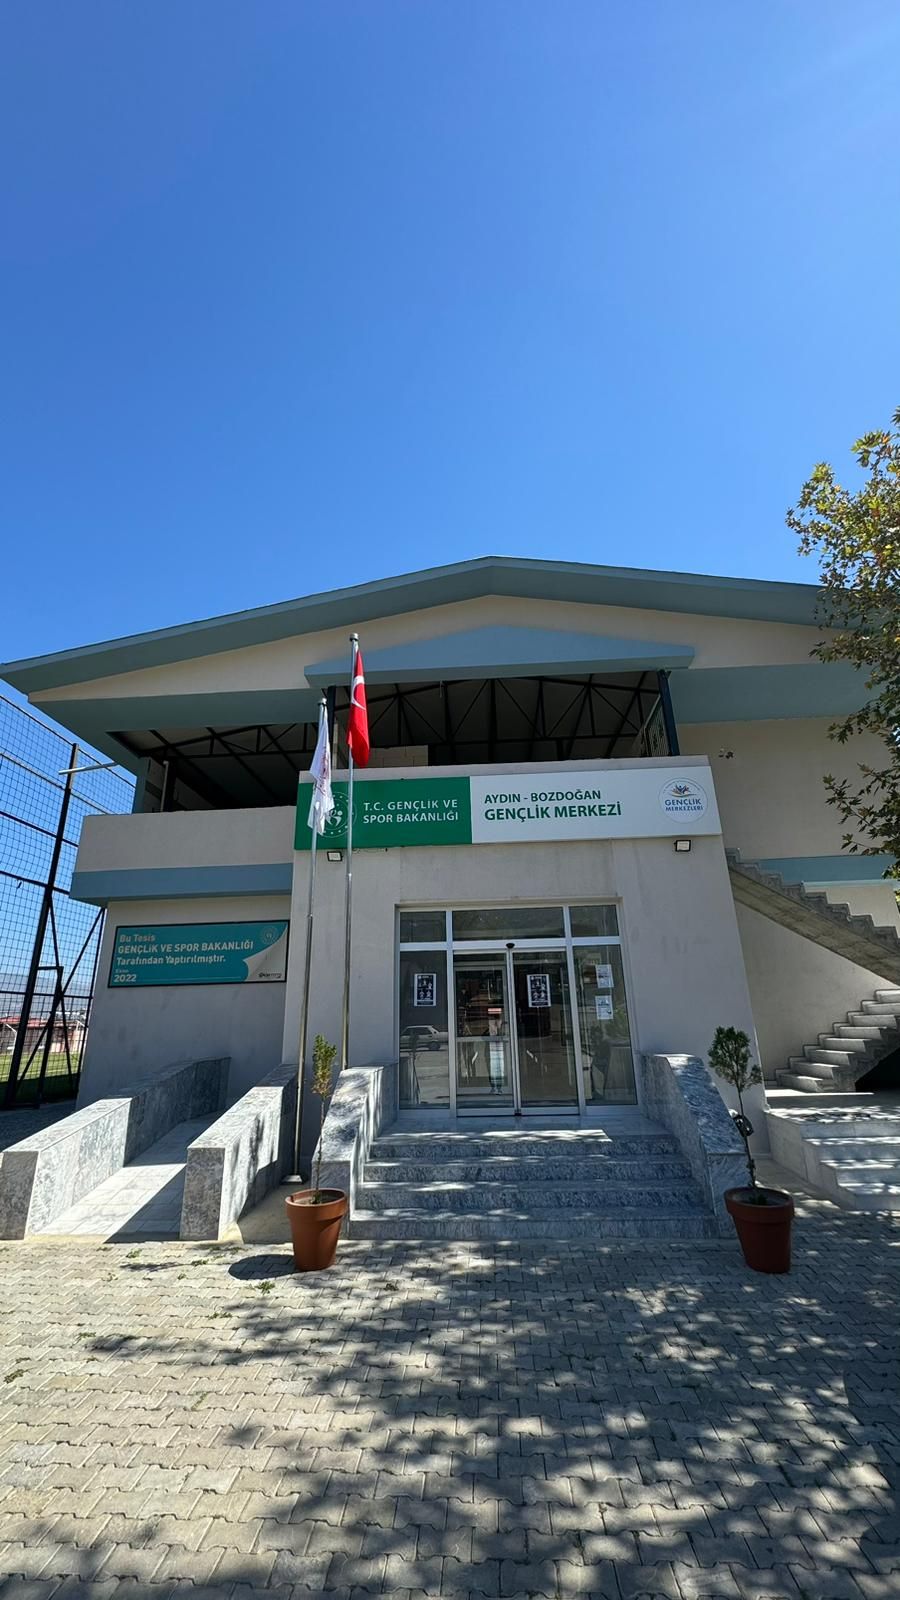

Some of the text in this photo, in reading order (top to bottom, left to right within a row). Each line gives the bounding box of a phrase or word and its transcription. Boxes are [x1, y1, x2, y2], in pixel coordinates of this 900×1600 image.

[484, 793, 521, 804] AYDIN
[530, 788, 601, 803] BOZDOĞAN
[363, 802, 384, 811] T.C.
[443, 799, 458, 808] VE
[362, 810, 459, 824] SPOR BAKANLIĞI
[484, 801, 622, 823] GENÇLİK MERKEZİ
[119, 934, 156, 943] Bu Tesis
[160, 943, 173, 953] VE
[174, 943, 199, 952] SPOR
[201, 939, 254, 952] BAKANLIĞI
[117, 956, 164, 966] Tarafından
[113, 973, 137, 983] 2022
